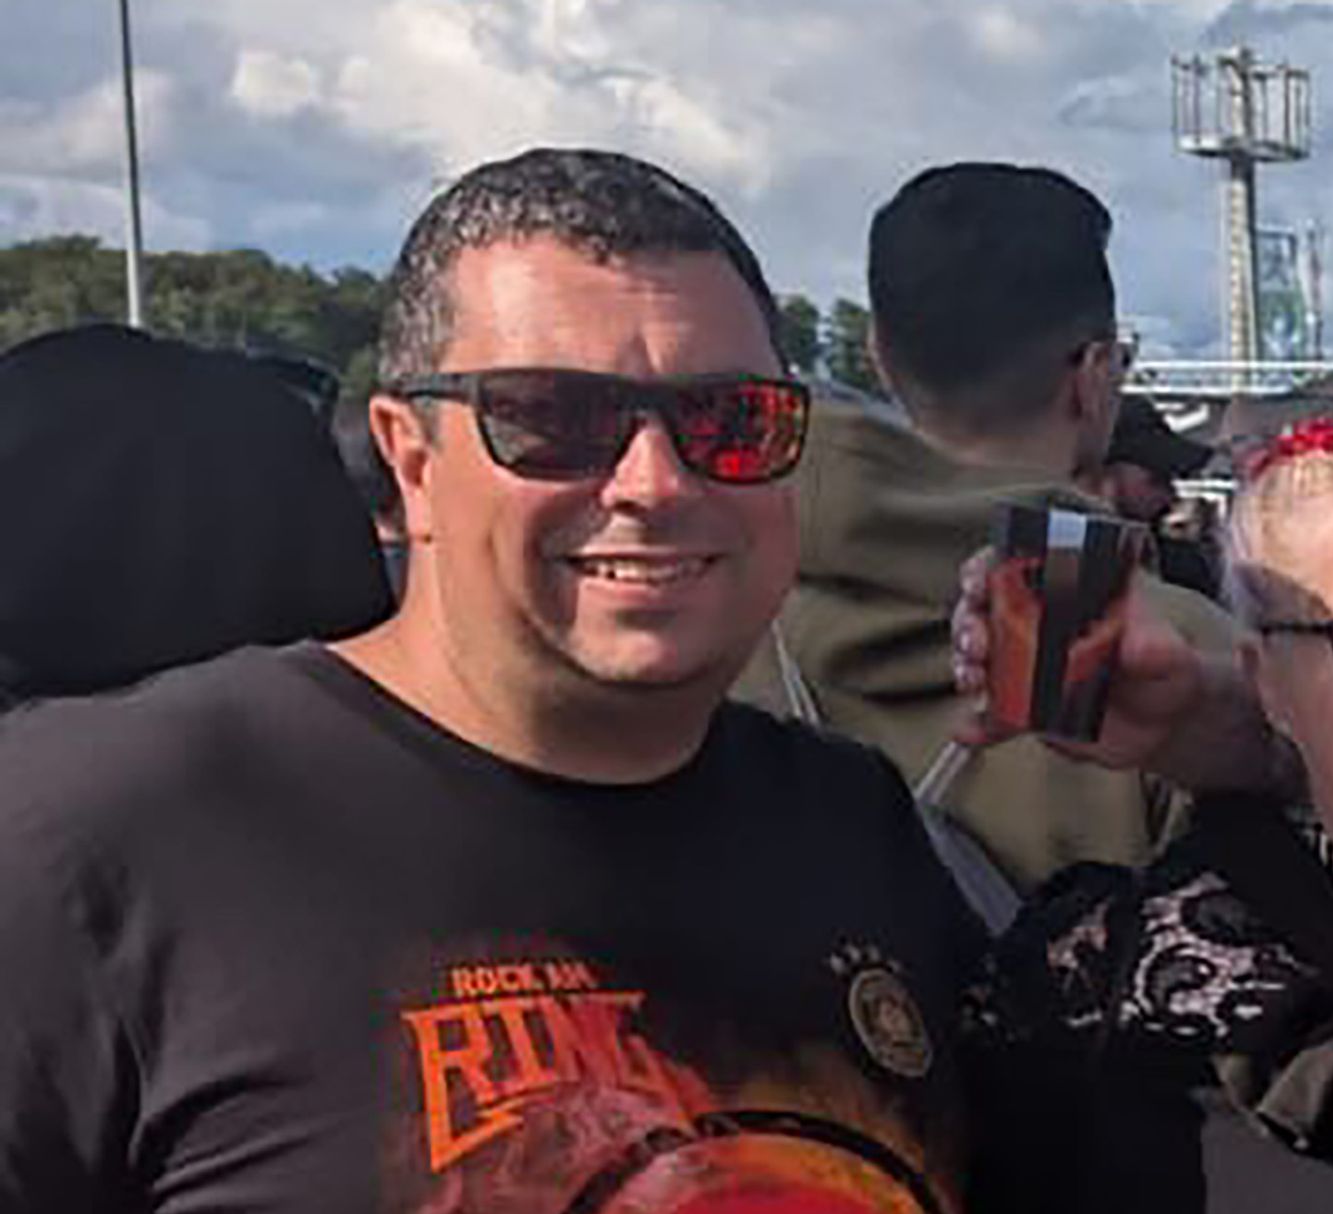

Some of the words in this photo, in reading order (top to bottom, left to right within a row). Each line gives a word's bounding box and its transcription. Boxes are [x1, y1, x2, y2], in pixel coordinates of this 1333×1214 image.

[451, 965, 543, 998] ROCK
[546, 961, 598, 990] AM
[401, 990, 700, 1174] RING
